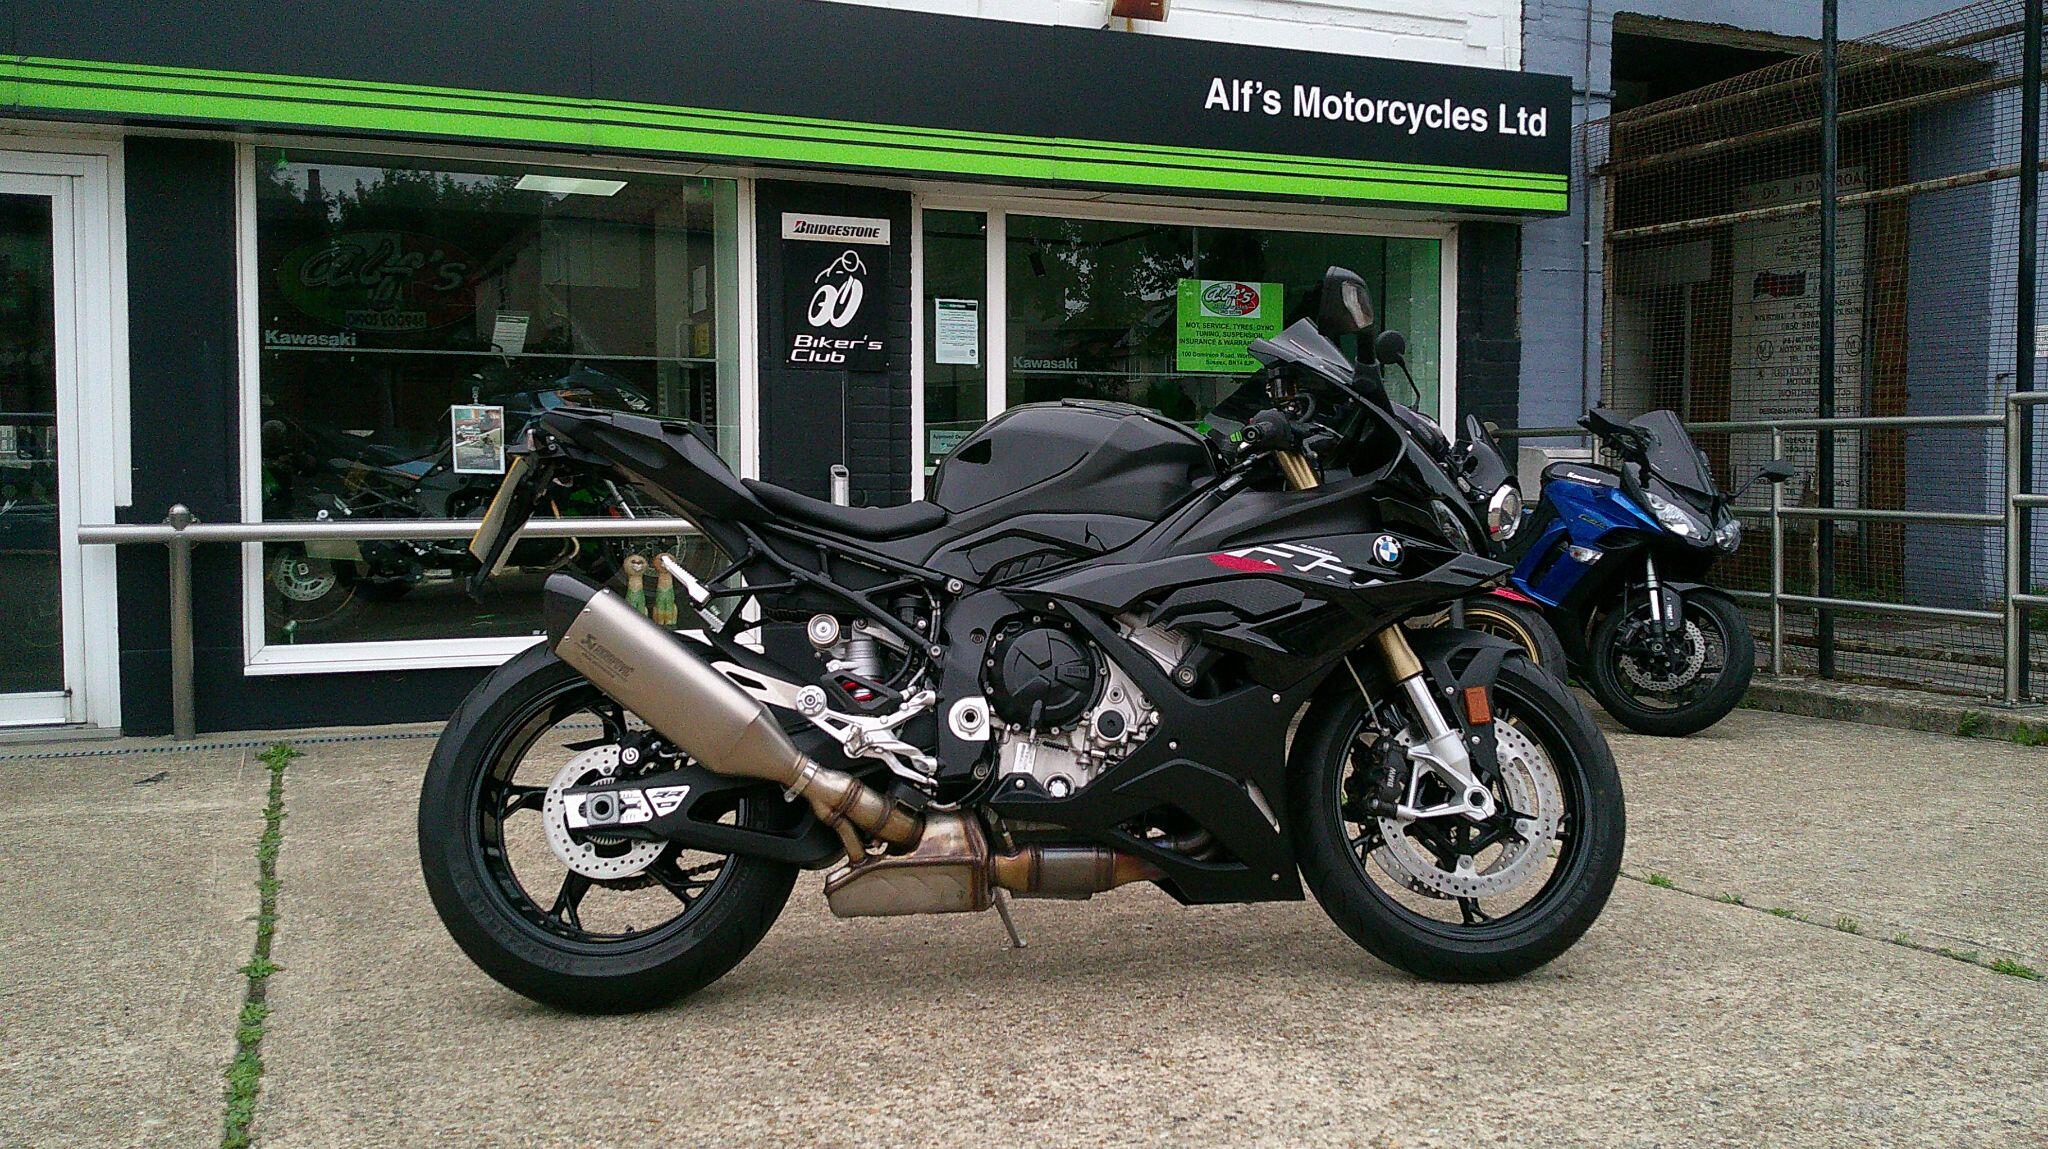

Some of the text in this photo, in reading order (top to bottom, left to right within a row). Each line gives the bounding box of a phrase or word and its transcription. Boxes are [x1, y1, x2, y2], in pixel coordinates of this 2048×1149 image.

[1204, 77, 1547, 137] Alf's Motorcycles Ltd
[793, 220, 881, 238] BRIDGESTONE
[265, 329, 357, 346] Kawasaki
[794, 334, 883, 350] Biker's
[790, 349, 845, 363] Club
[1013, 356, 1078, 369] Kawasaki
